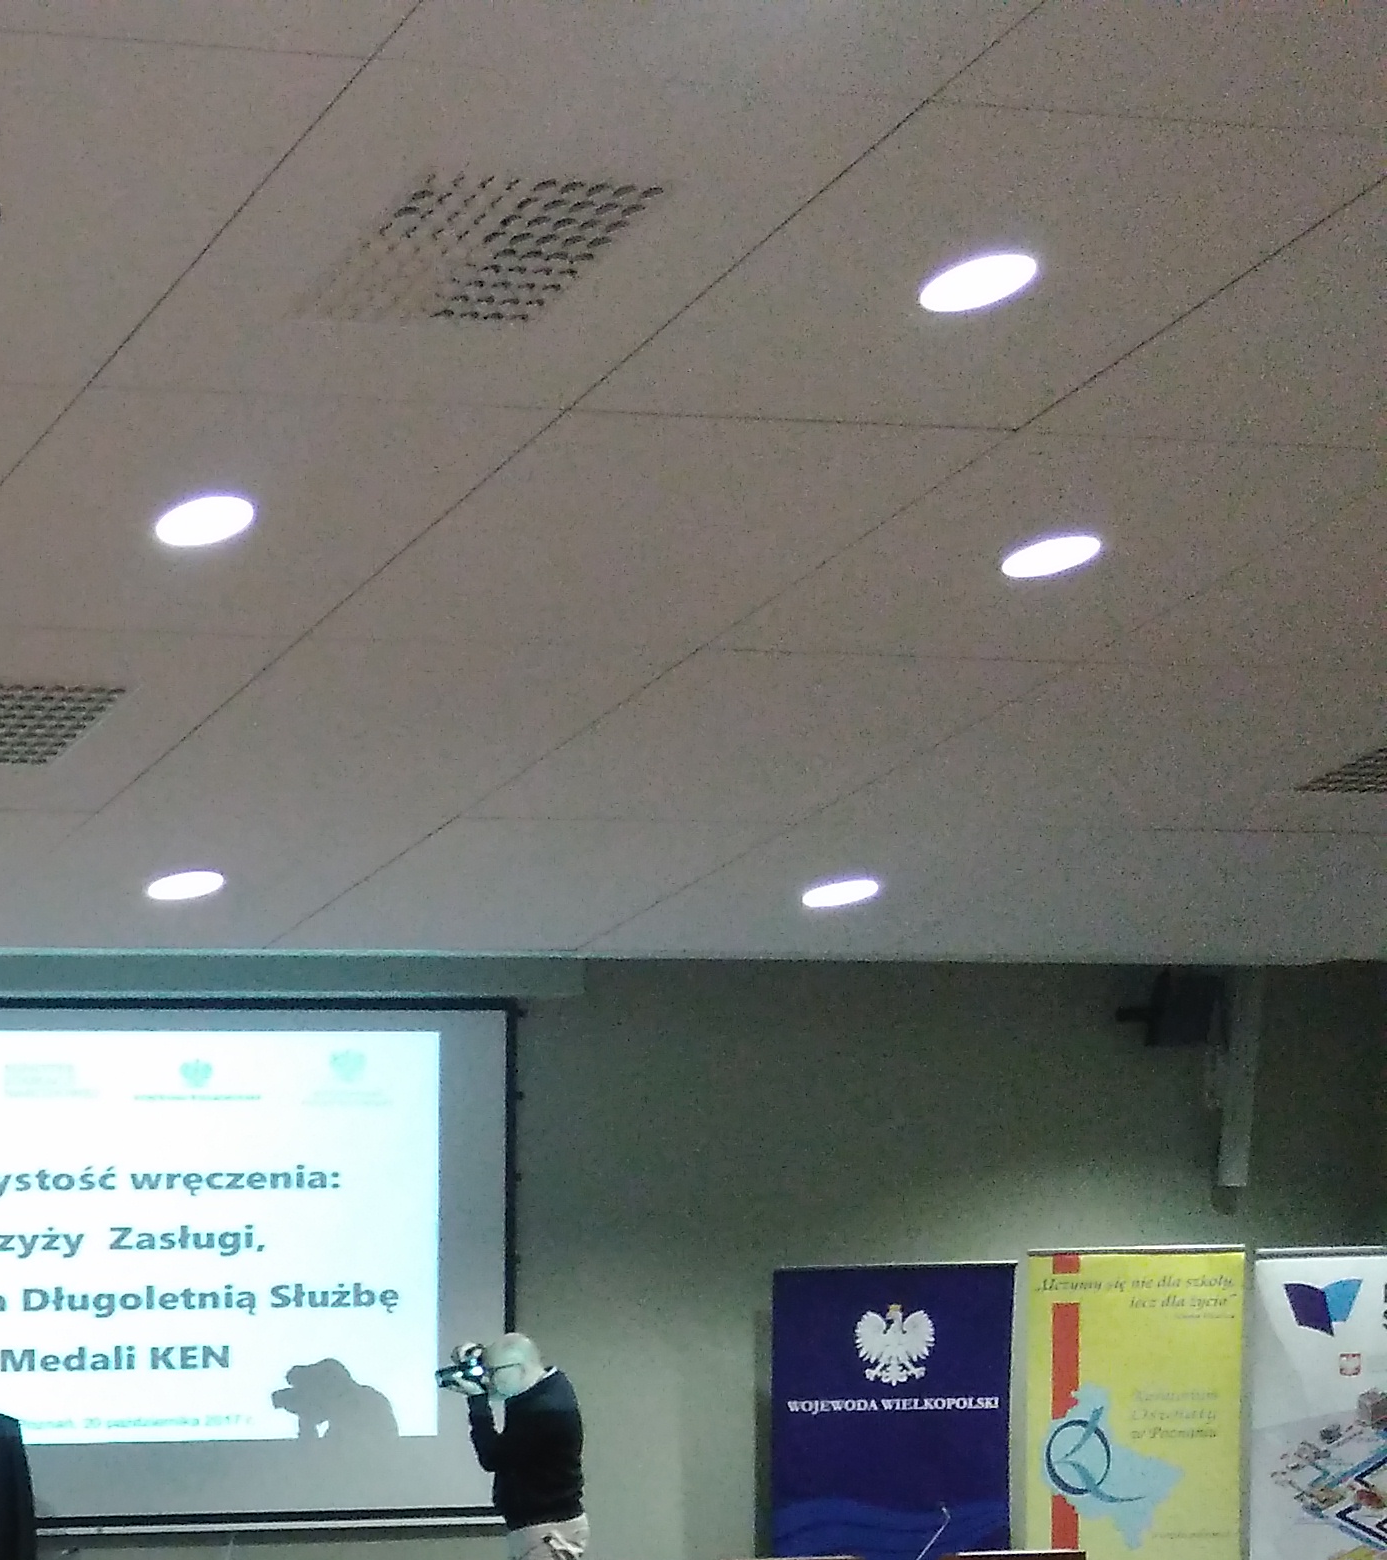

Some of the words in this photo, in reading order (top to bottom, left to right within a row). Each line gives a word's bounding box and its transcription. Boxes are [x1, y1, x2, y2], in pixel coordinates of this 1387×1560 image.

[130, 1164, 341, 1197] wręczenia:
[108, 1224, 266, 1257] Zasługi,
[1158, 1275, 1181, 1289] dla
[22, 1284, 258, 1319] Długoletnią
[270, 1282, 401, 1314] Służbę
[0, 1345, 136, 1373] Medali
[149, 1344, 231, 1370] KEN
[786, 1399, 879, 1416] WOJEWODA
[880, 1396, 1000, 1412] WIELKOPOLSKI
